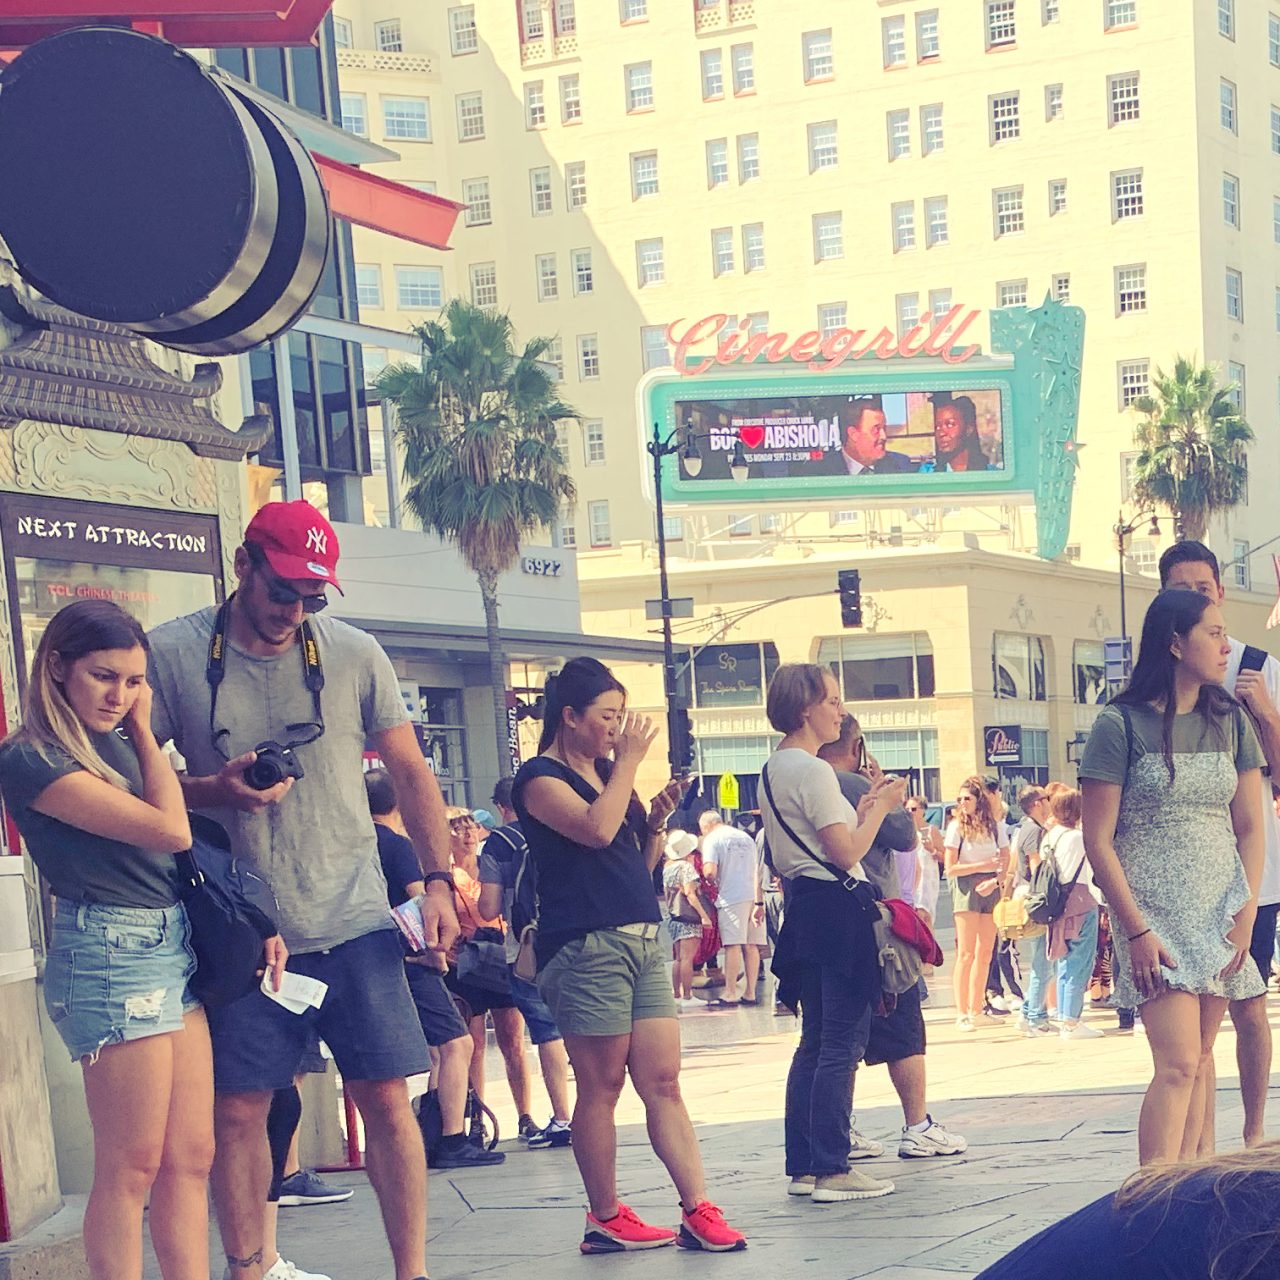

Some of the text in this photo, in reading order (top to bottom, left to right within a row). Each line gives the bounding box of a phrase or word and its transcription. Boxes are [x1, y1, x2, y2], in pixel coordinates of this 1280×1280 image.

[665, 303, 982, 376] Cinegrill
[763, 415, 841, 451] ABISHOLA
[18, 516, 207, 553] NEXT ATTRACTION
[48, 584, 74, 598] TCL
[76, 585, 115, 600] CHINESE
[986, 727, 1020, 754] Public
